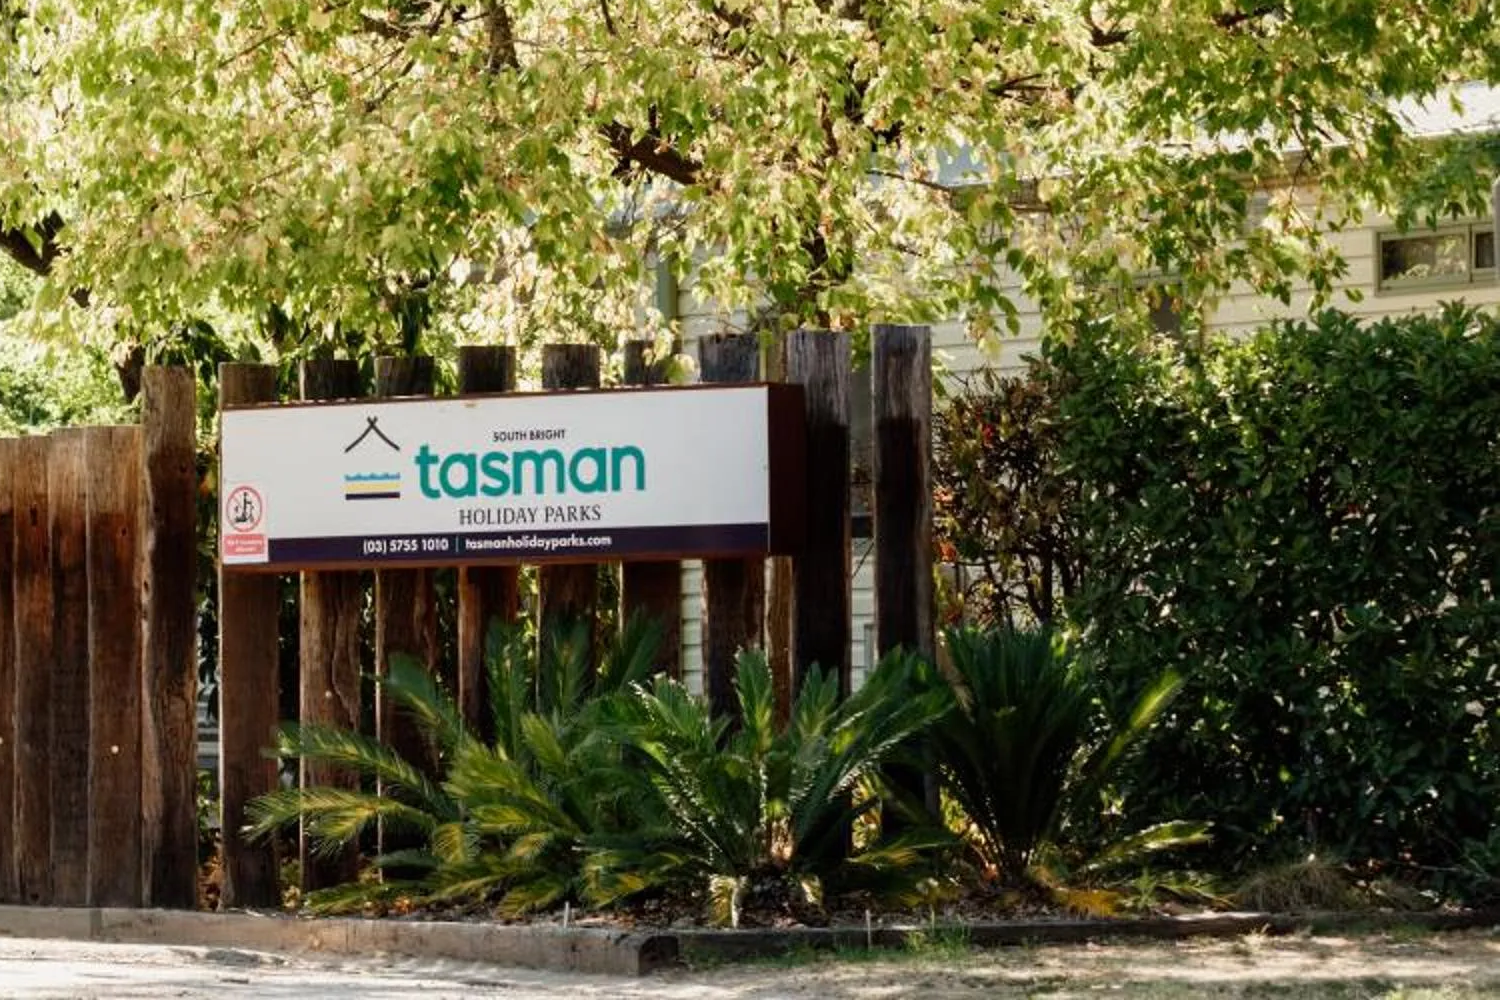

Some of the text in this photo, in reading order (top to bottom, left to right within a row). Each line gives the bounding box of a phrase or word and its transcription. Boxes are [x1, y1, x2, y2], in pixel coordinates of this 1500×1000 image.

[492, 428, 566, 442] SOUTH BRIGHT
[414, 444, 646, 499] tasman
[459, 504, 602, 526] HOLIDAY PARKS
[363, 537, 449, 554] (03) 5755 1010
[465, 534, 613, 551] tasmanholidayparks.com
